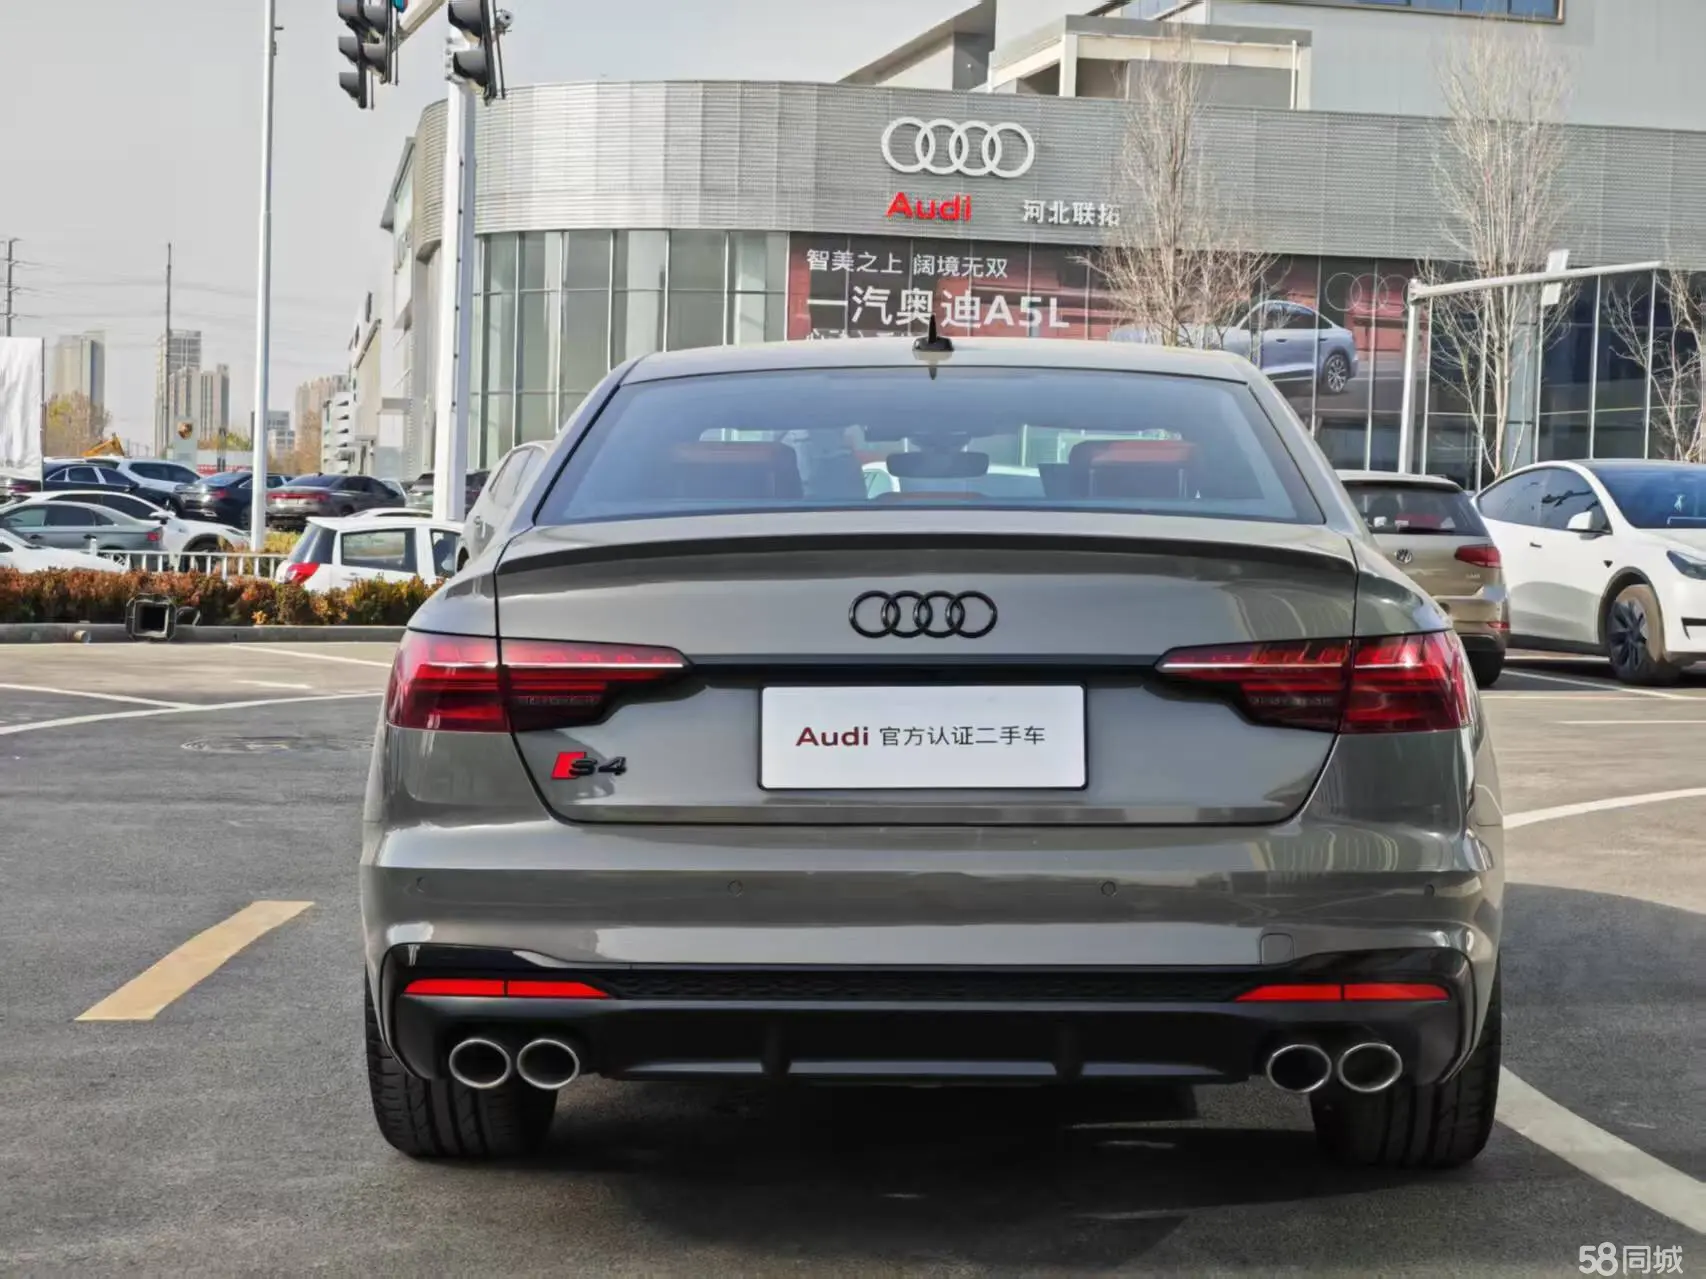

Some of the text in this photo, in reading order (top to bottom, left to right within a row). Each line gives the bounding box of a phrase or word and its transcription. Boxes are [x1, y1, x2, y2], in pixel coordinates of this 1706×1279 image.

[886, 192, 972, 221] Audi
[1023, 200, 1121, 227] 河北联拓
[806, 249, 1008, 278] 智美之上 阔境无双
[806, 285, 1070, 329] 一汽奥迪A5L
[796, 726, 1046, 747] Audi 官方认证二手车
[555, 752, 627, 778] S4
